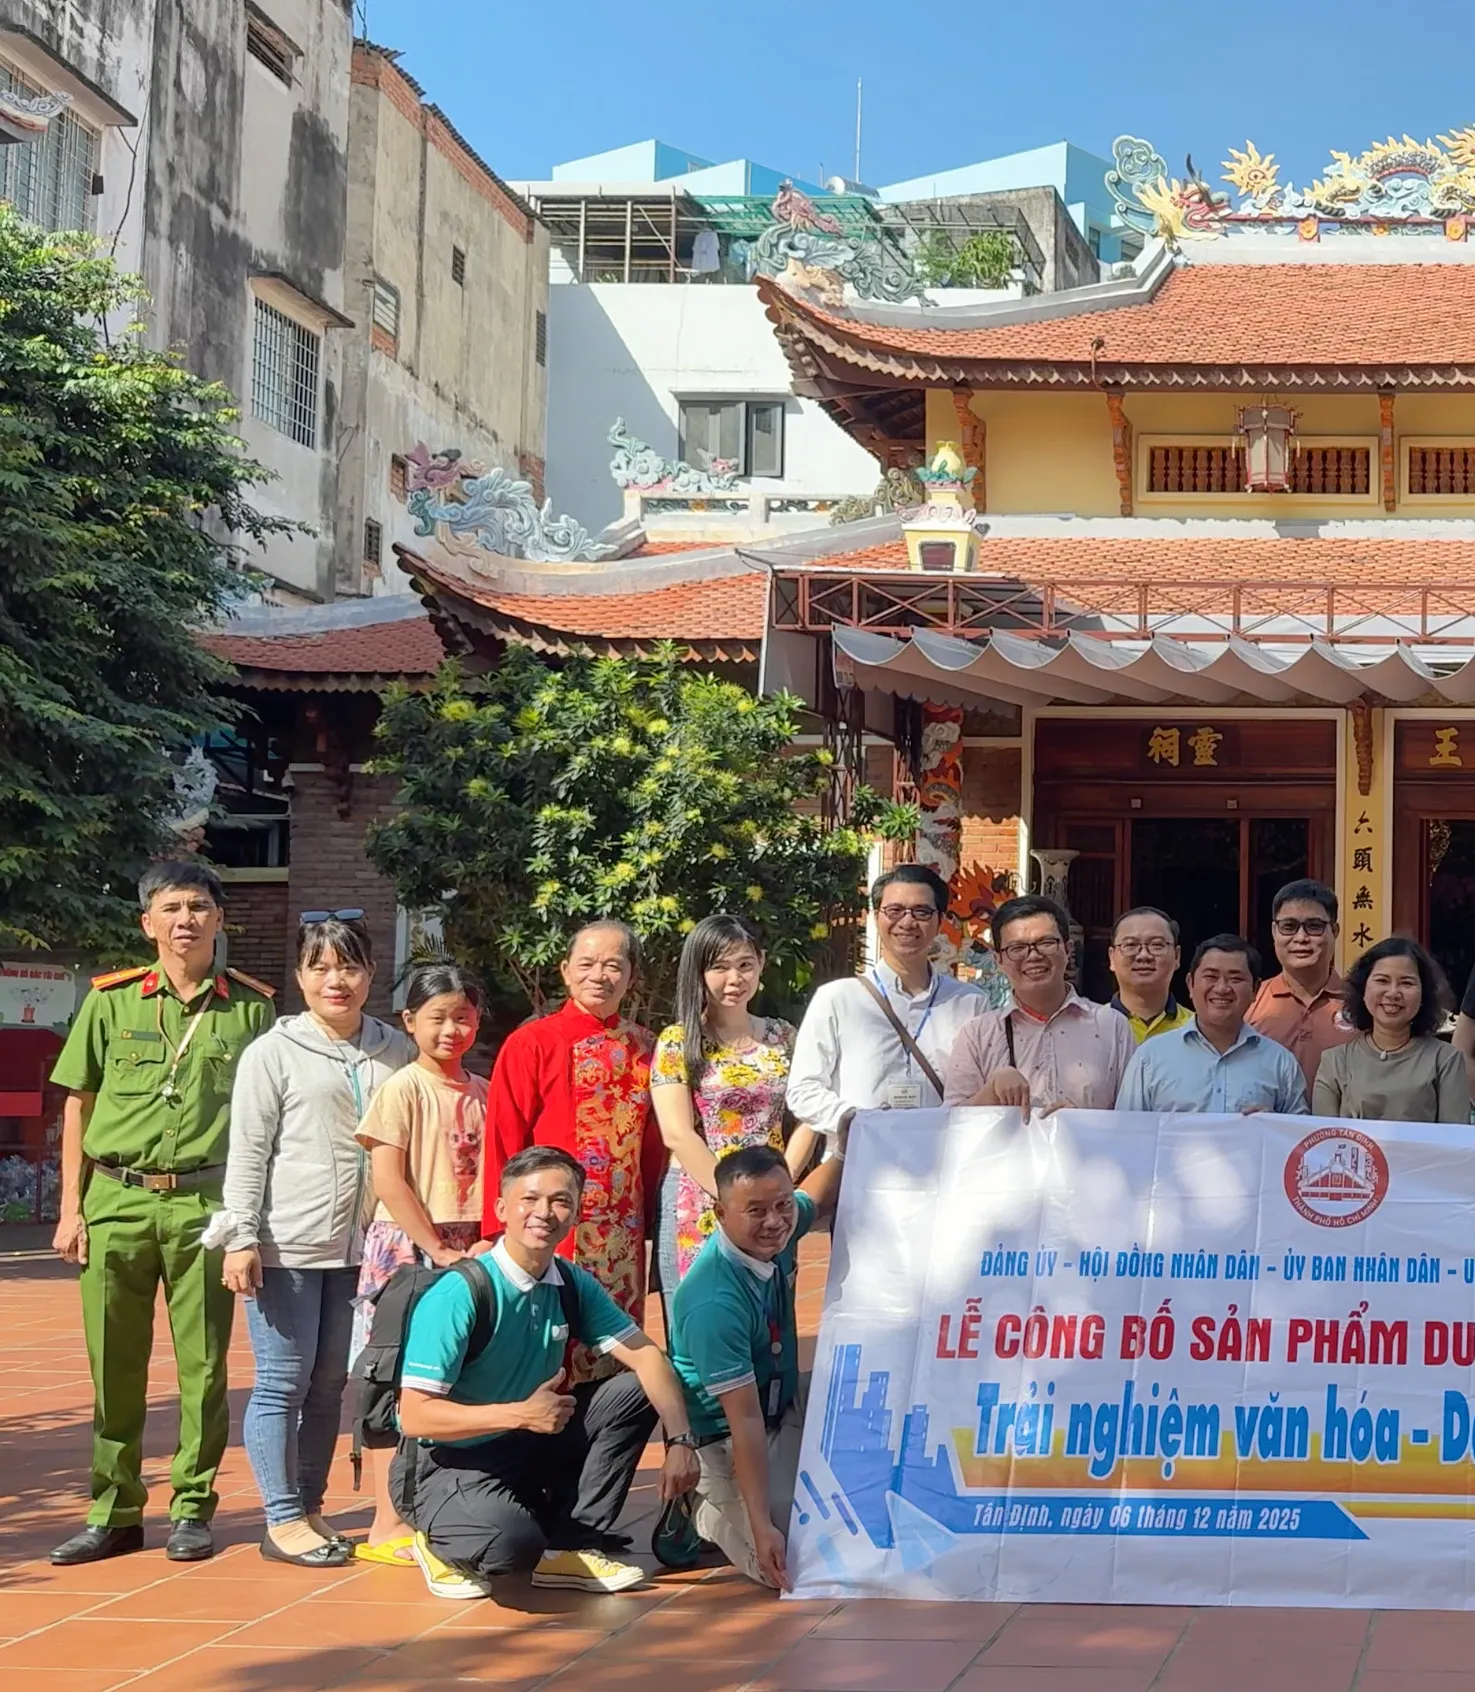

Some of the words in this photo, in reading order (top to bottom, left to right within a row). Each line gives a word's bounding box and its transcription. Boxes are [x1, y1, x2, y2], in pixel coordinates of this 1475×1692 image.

[980, 1243, 1029, 1278] ĐẢNG
[1079, 1245, 1109, 1282] HỘI
[1115, 1242, 1165, 1278] ĐỒNG
[1170, 1249, 1218, 1280] NHÂN
[1224, 1249, 1261, 1281] DÂN
[1283, 1247, 1307, 1282] ỦY
[1311, 1255, 1347, 1282] BAN
[1353, 1251, 1400, 1284] NHÂN
[1406, 1252, 1441, 1285] DÂN
[935, 1297, 984, 1360] LỄ
[993, 1305, 1106, 1361] CÔNG
[1119, 1298, 1176, 1362] BỐ
[1189, 1303, 1272, 1363] SẢN
[1286, 1300, 1409, 1366] PHẨM
[975, 1380, 1056, 1457] Trải
[1065, 1379, 1220, 1480] nghiệm
[1235, 1391, 1310, 1461] văn
[1324, 1383, 1400, 1463] hóa
[973, 1502, 1005, 1527] Tân
[1060, 1502, 1105, 1530] ngày
[1108, 1504, 1132, 1528] 06
[1136, 1503, 1187, 1530] tháng
[1193, 1506, 1210, 1529] 12
[1215, 1503, 1253, 1530] năm
[1257, 1507, 1302, 1530] 2025
